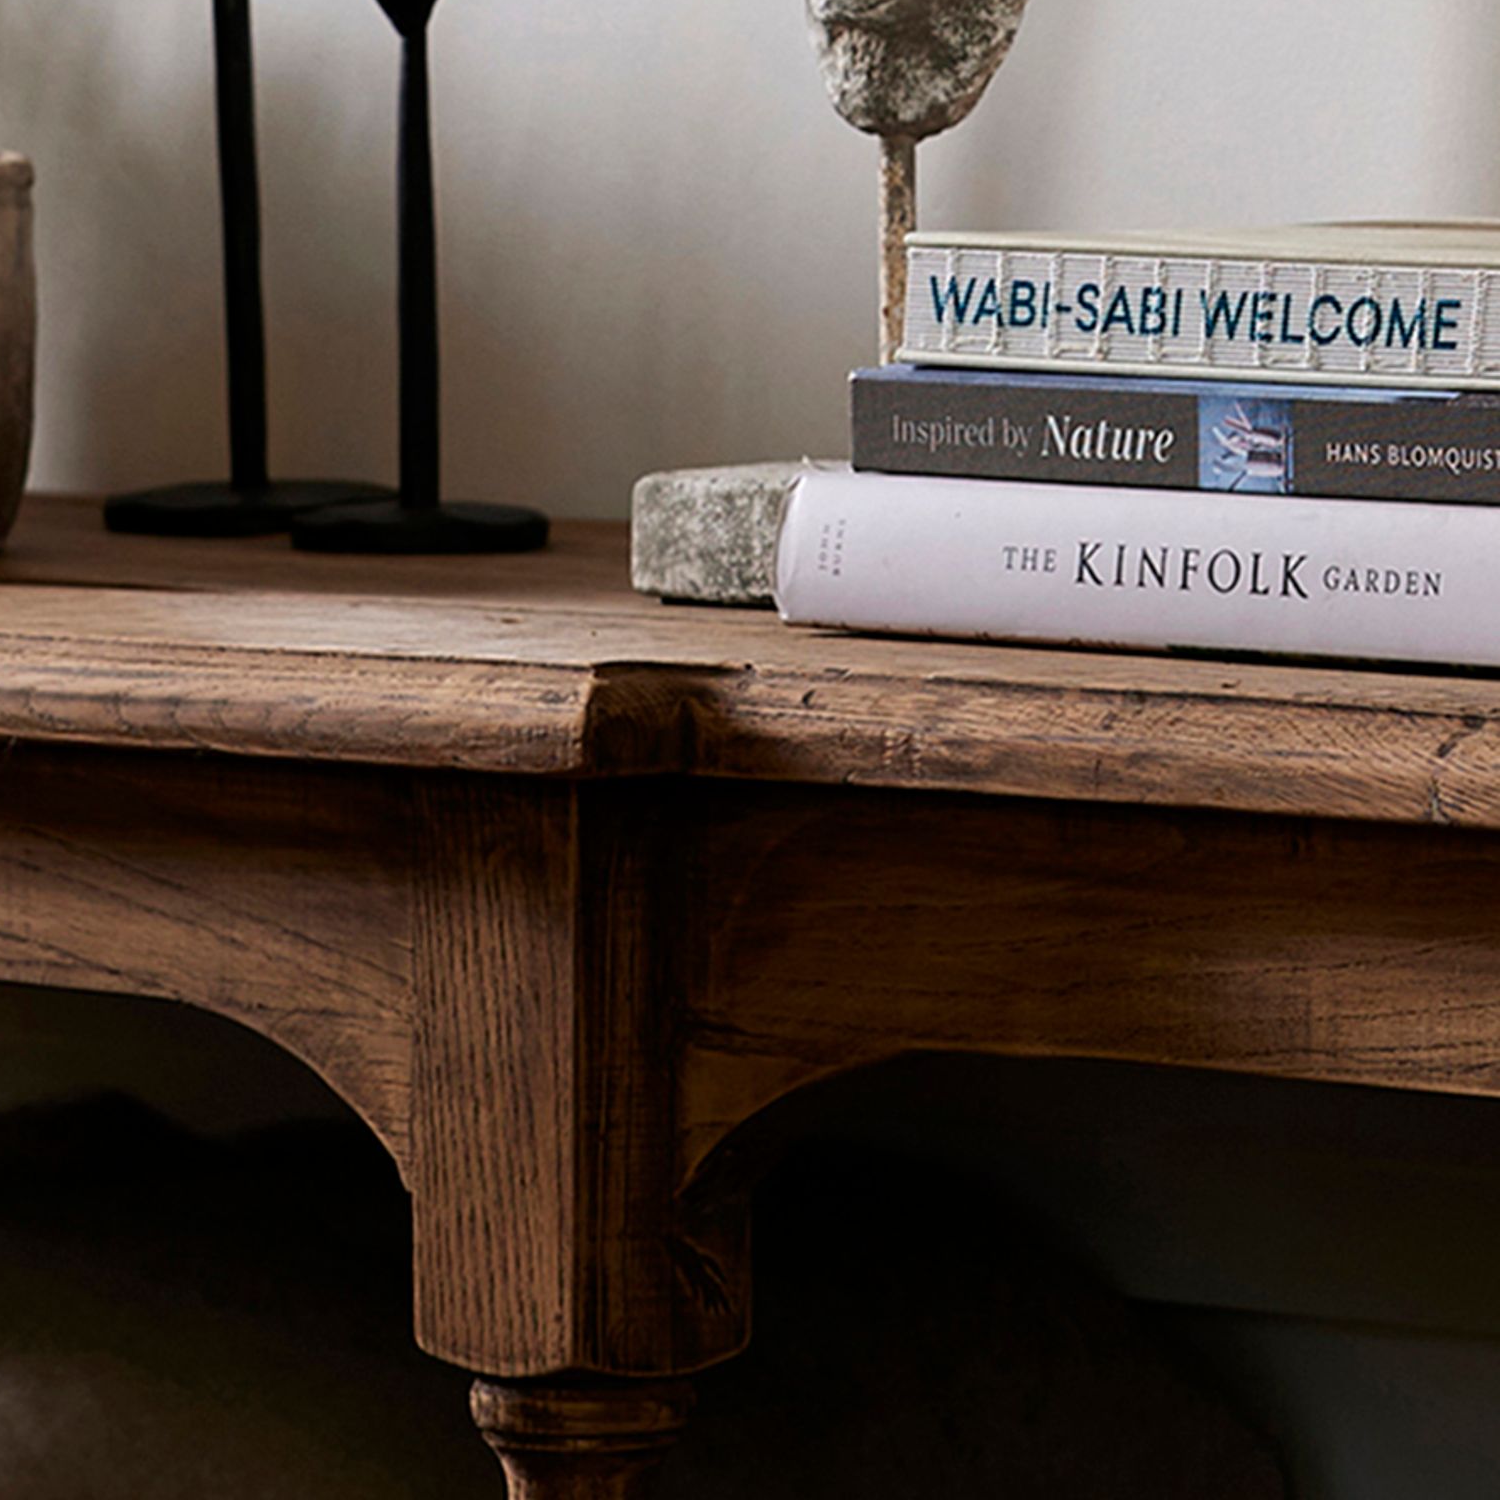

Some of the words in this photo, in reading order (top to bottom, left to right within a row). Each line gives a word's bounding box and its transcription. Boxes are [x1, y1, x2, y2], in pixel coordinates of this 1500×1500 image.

[929, 275, 1183, 337] WABI-SABI
[1200, 289, 1462, 350] WELCOME
[892, 414, 994, 451] Inspired
[1002, 418, 1033, 457] by
[1040, 414, 1175, 463] Nature
[1325, 442, 1381, 465] HANS
[1002, 546, 1058, 573] THE
[1074, 542, 1309, 599] KINFOLK
[1322, 566, 1443, 597] GARDEN
